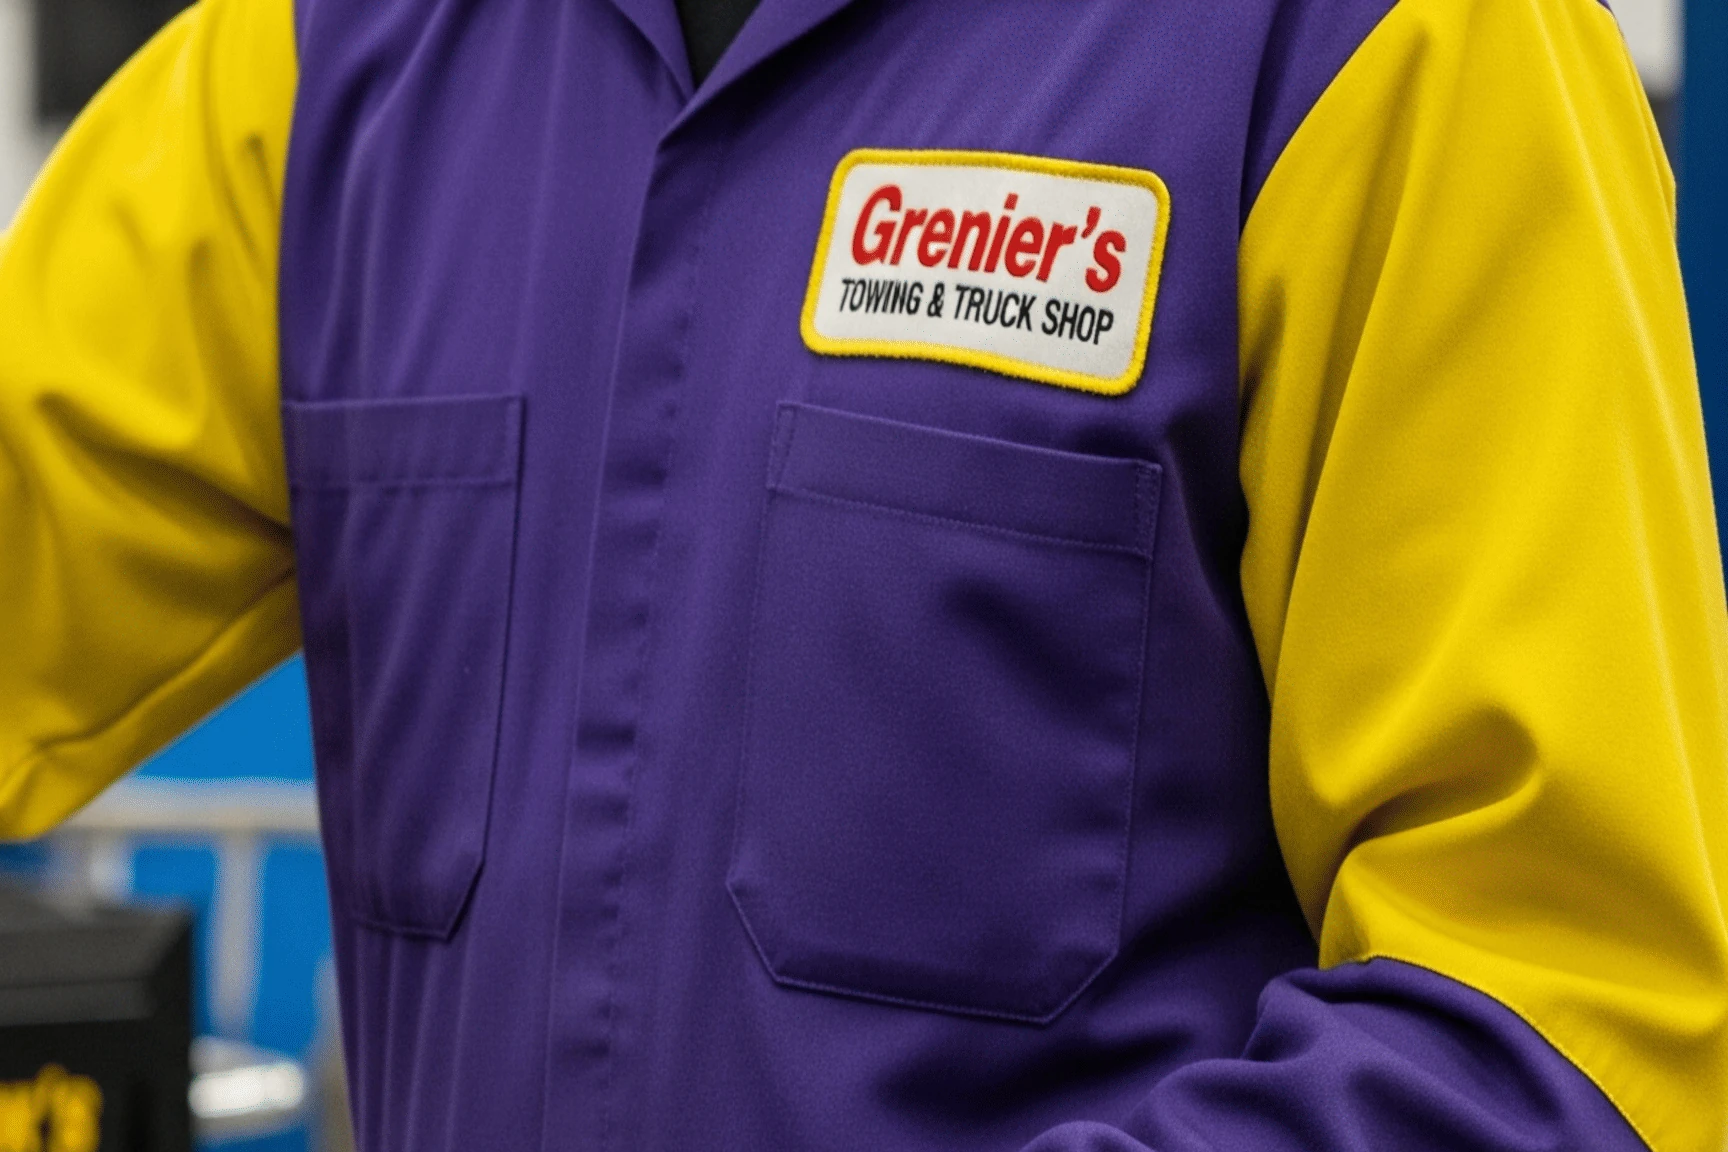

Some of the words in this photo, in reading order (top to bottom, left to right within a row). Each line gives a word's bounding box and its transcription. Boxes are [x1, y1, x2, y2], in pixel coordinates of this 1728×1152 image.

[851, 184, 1126, 292] Grenier's
[839, 278, 922, 315] TOWING
[927, 282, 945, 318] &
[954, 285, 1036, 332] TRUCK
[1041, 298, 1114, 345] SHOP
